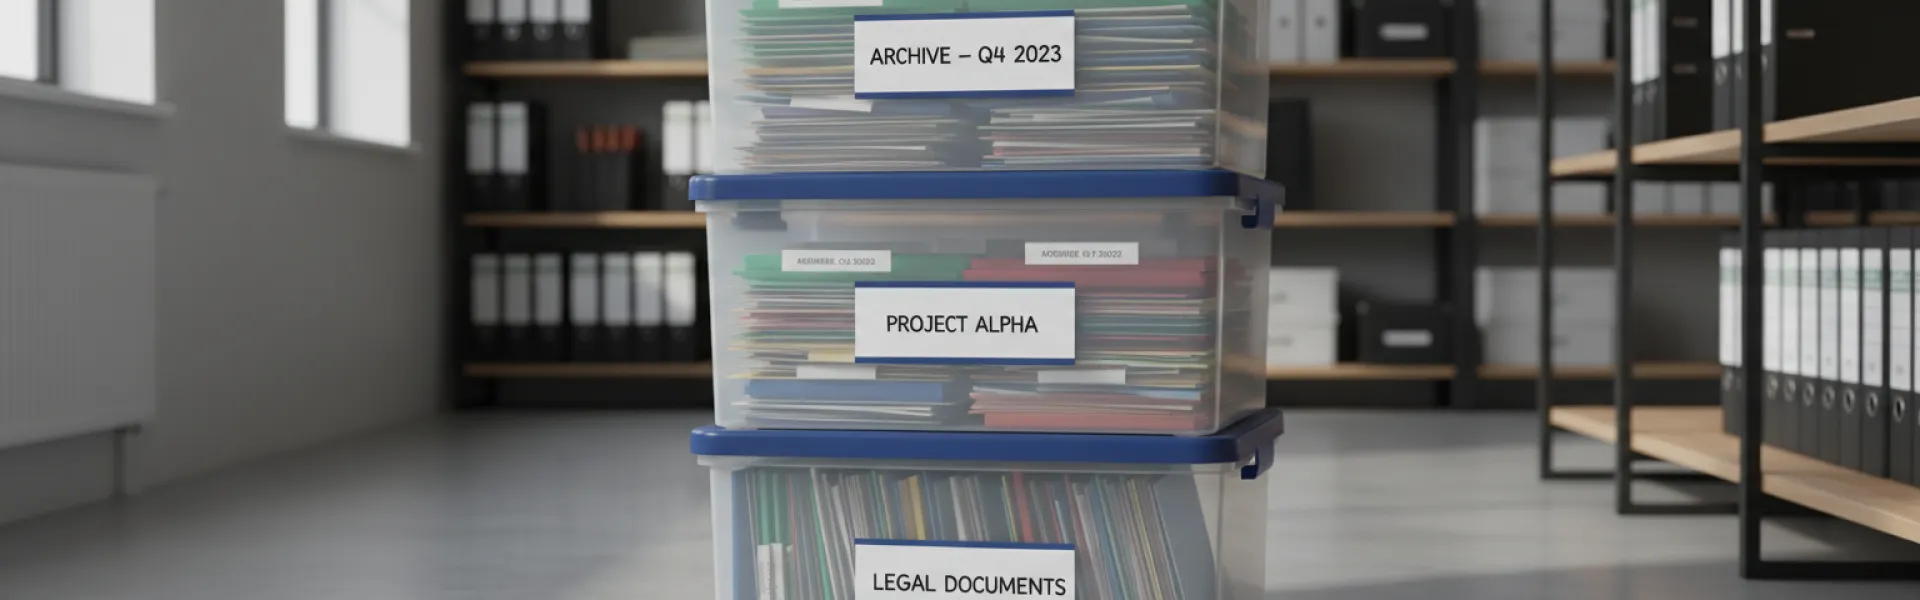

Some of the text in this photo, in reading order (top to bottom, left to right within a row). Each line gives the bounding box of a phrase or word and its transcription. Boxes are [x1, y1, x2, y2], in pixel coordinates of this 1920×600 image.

[869, 46, 952, 66] ARCHIVE
[977, 45, 1006, 64] Q4
[1013, 44, 1062, 64] 2023
[886, 314, 1039, 334] PROJECT ALPHA
[873, 573, 1067, 597] LEGAL DOCUMENTS
